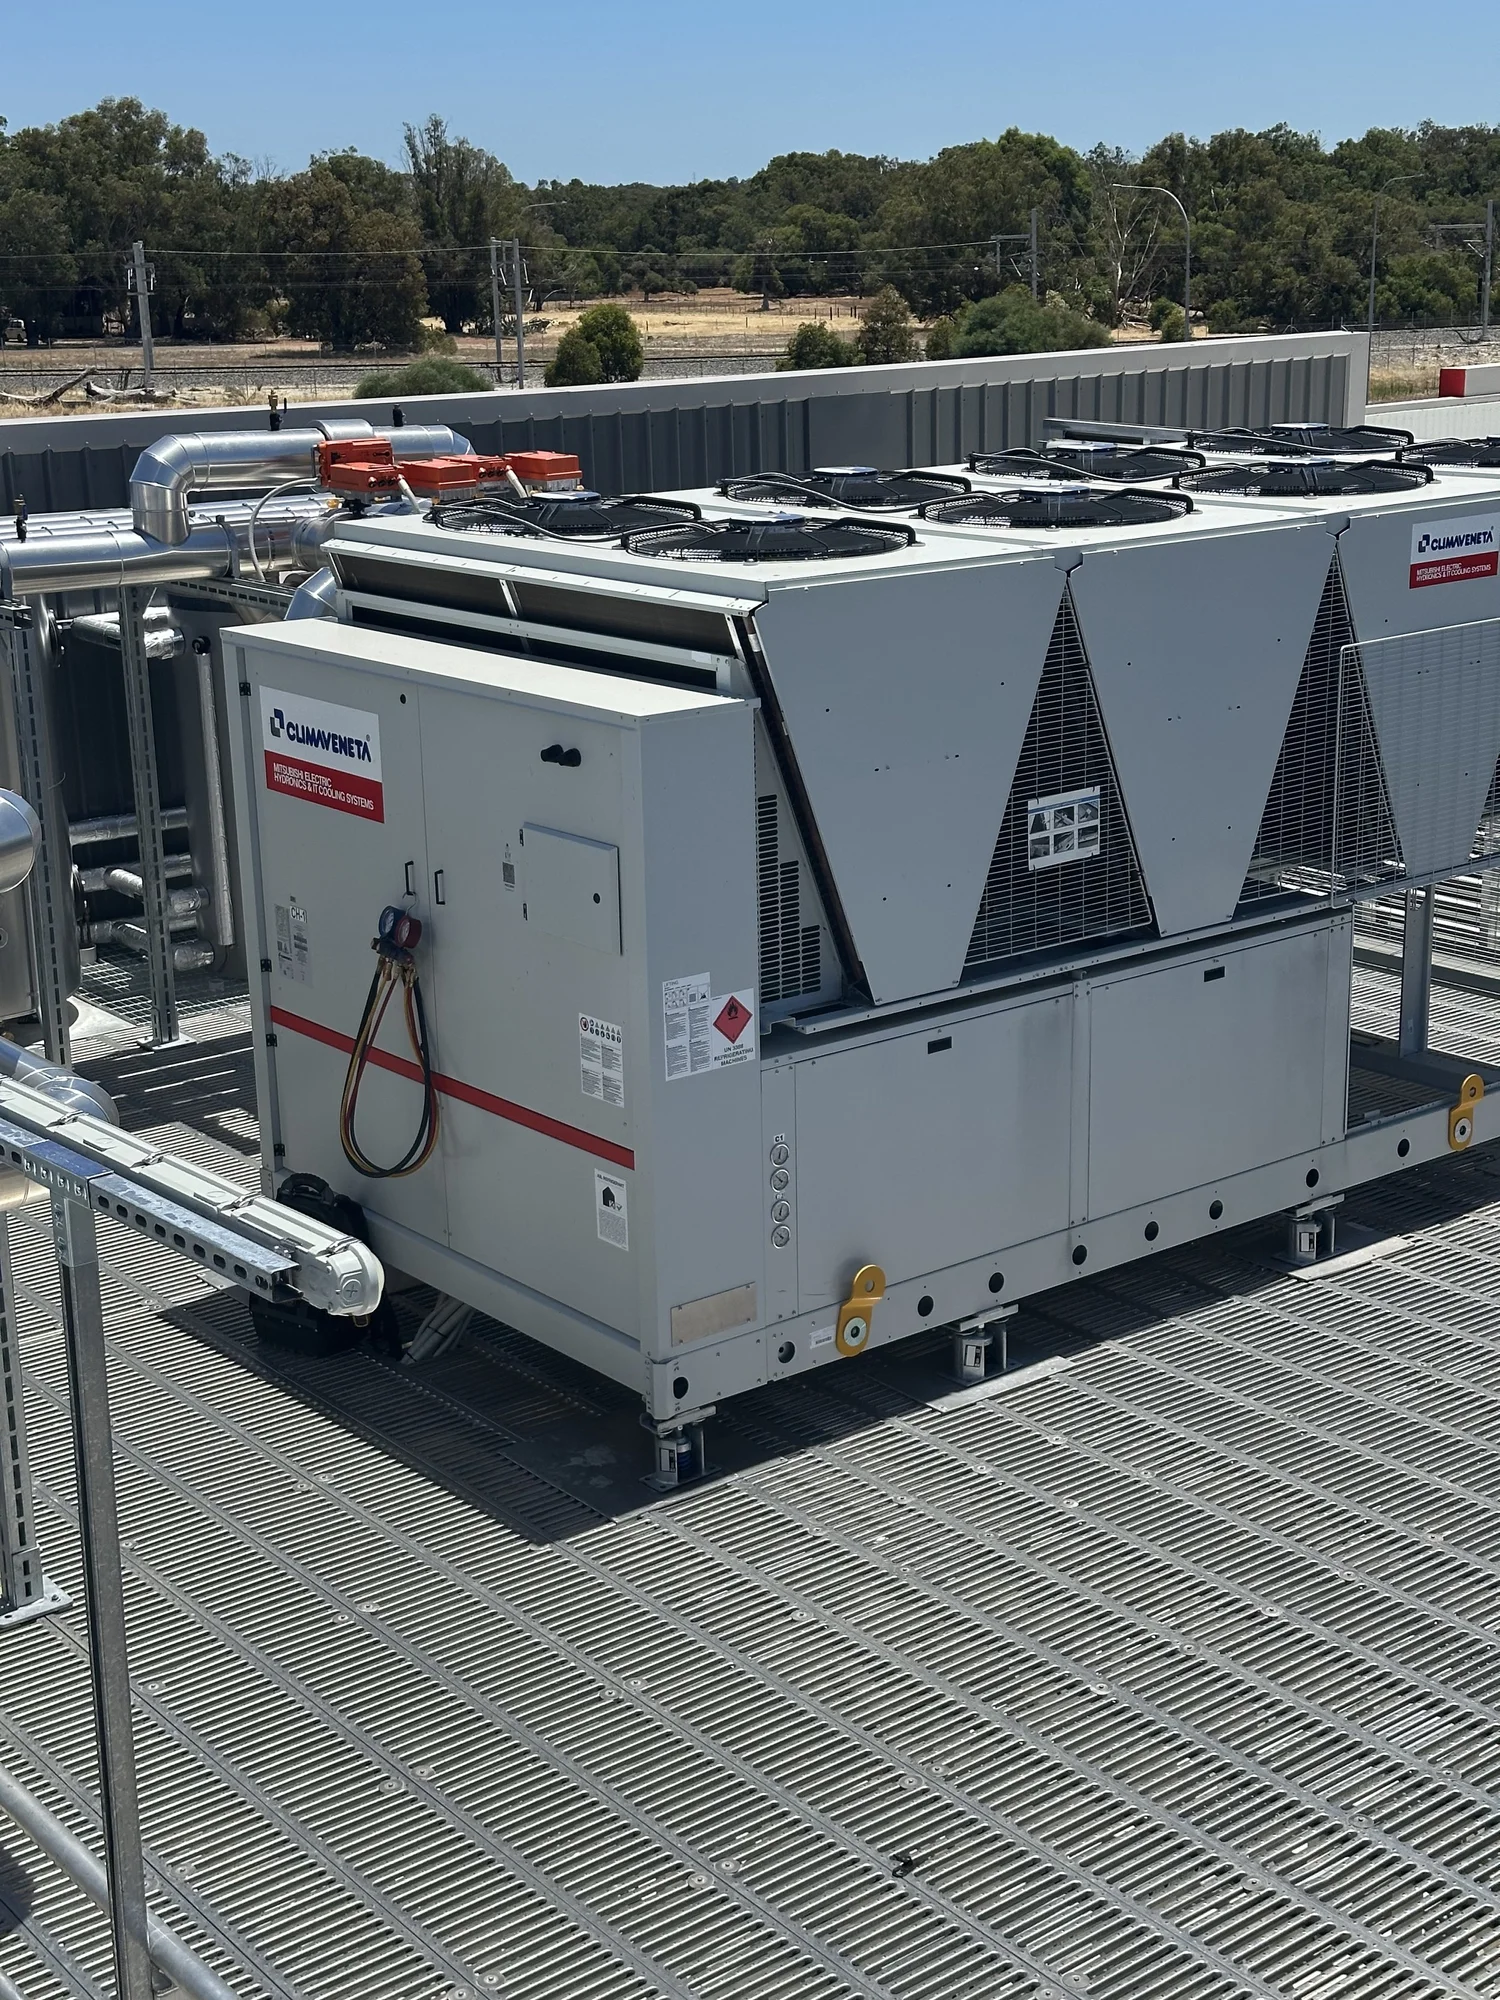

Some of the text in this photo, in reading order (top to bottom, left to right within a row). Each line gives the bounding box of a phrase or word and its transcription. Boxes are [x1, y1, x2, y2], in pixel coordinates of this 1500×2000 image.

[1431, 531, 1493, 550] CLIMAVENETA
[1441, 563, 1462, 572] ELECTRIC
[1451, 567, 1471, 576] COOLING
[1471, 564, 1491, 573] SYSTEMS
[286, 721, 372, 763] CLIMAVENETA
[273, 762, 332, 788] MITSUBISHI ELECTRIC
[274, 774, 374, 811] HYDRONICS & IT COOLING SYSTEMS
[720, 1055, 748, 1066] MACHINES
[775, 1134, 784, 1142] C1
